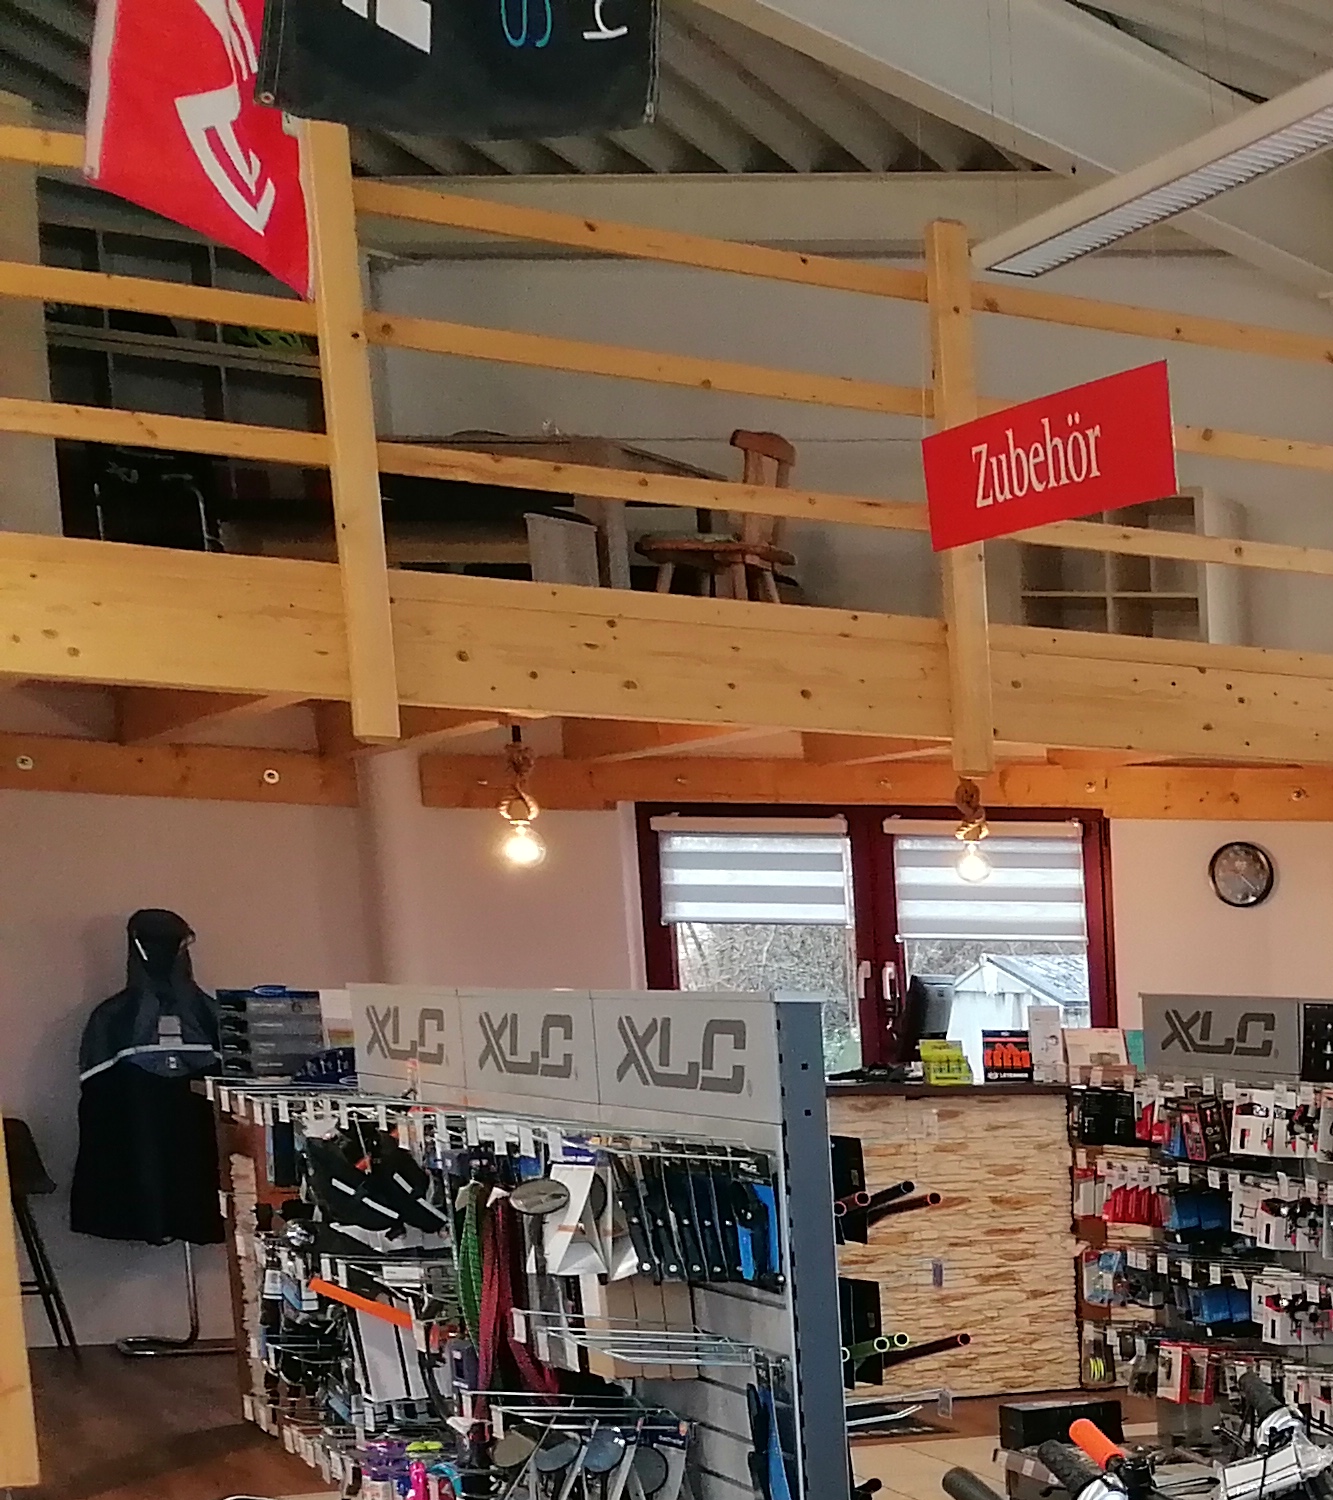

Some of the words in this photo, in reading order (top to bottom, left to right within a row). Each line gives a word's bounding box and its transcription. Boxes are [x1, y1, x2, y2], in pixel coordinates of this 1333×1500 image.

[972, 412, 1102, 509] Zubehör
[366, 1005, 445, 1065] XLC
[479, 1011, 573, 1078] XLC
[616, 1015, 747, 1094] XLC
[1161, 1009, 1276, 1058] XLC
